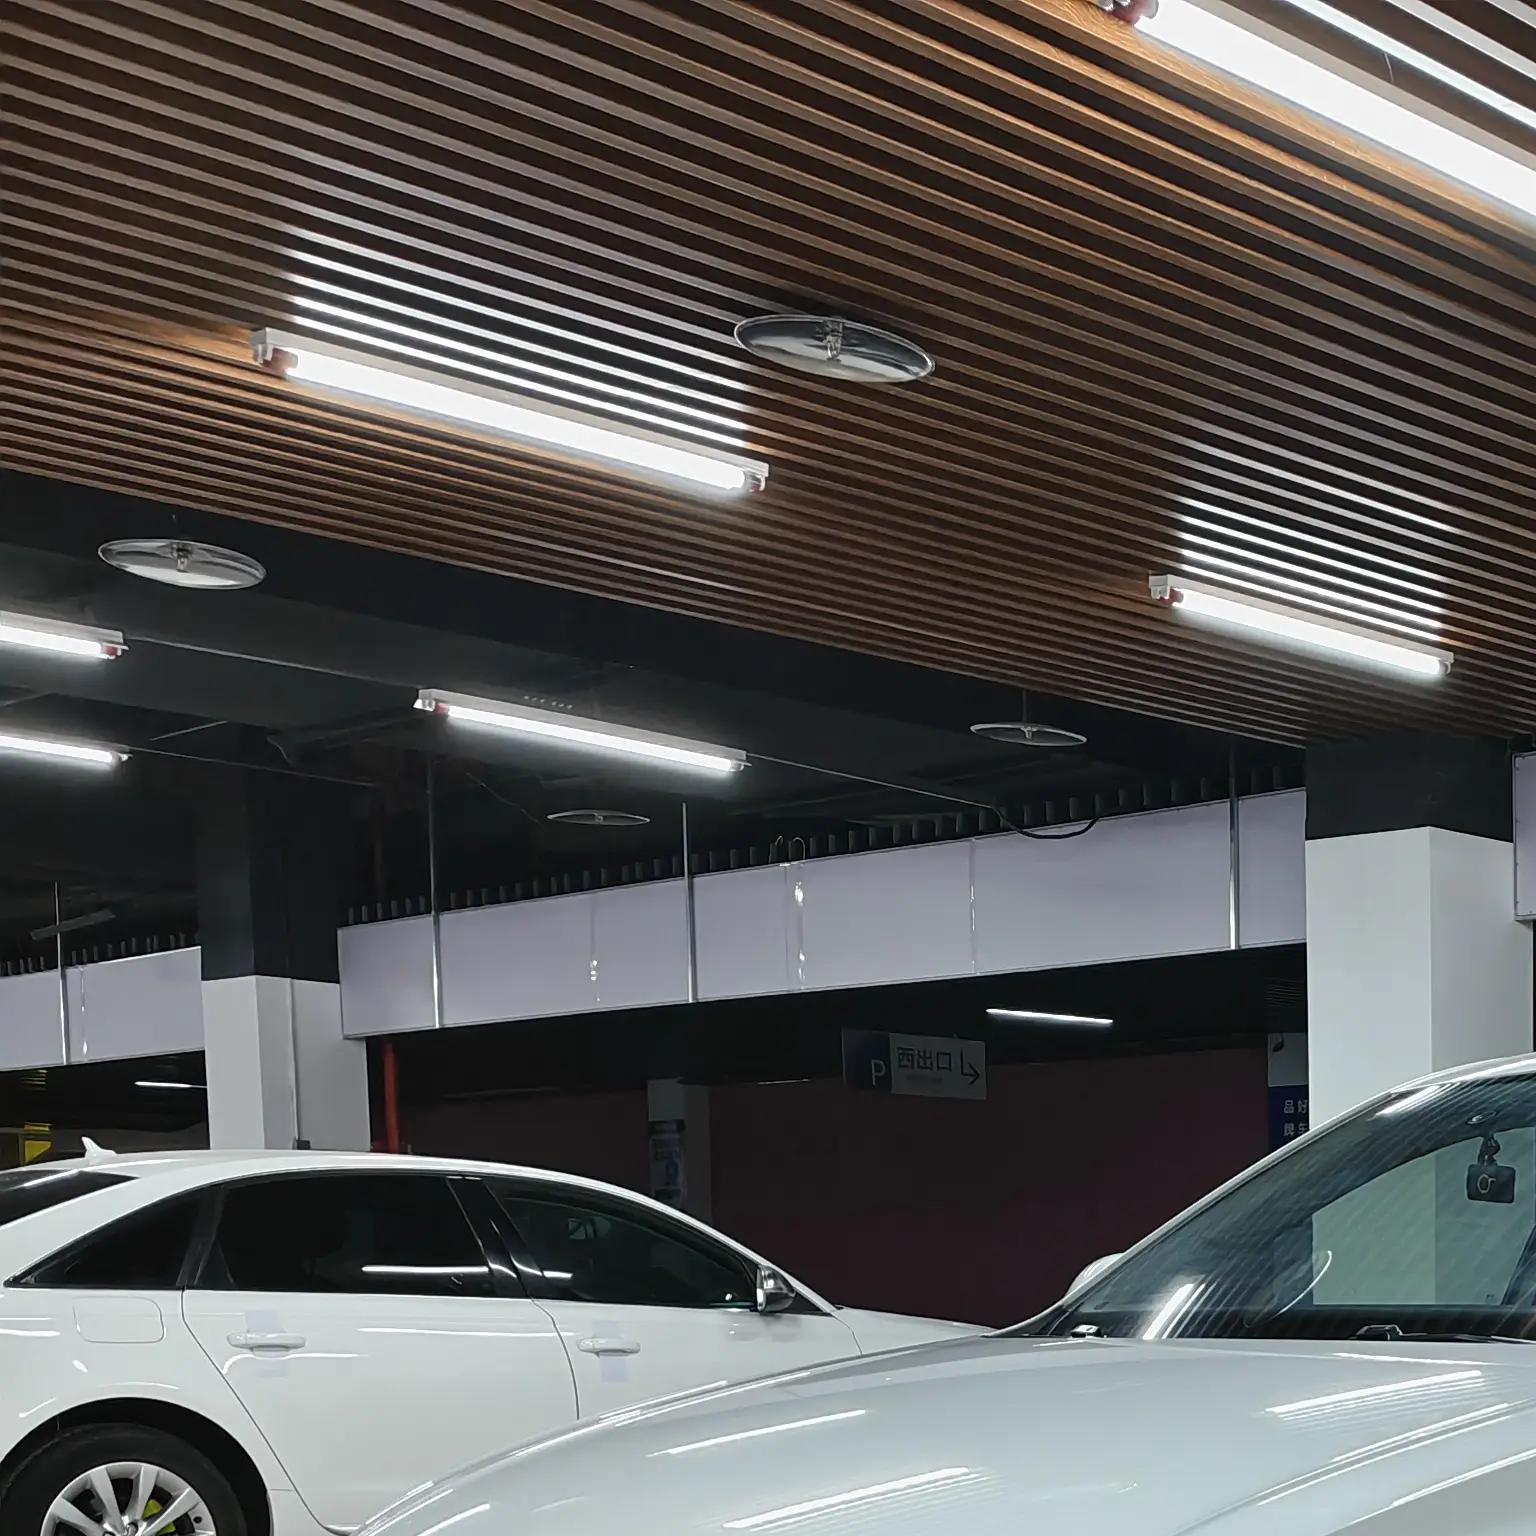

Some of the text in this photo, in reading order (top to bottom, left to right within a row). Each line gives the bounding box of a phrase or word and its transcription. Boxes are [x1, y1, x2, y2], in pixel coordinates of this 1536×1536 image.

[871, 1059, 886, 1086] P
[897, 1047, 952, 1072] 西出口
